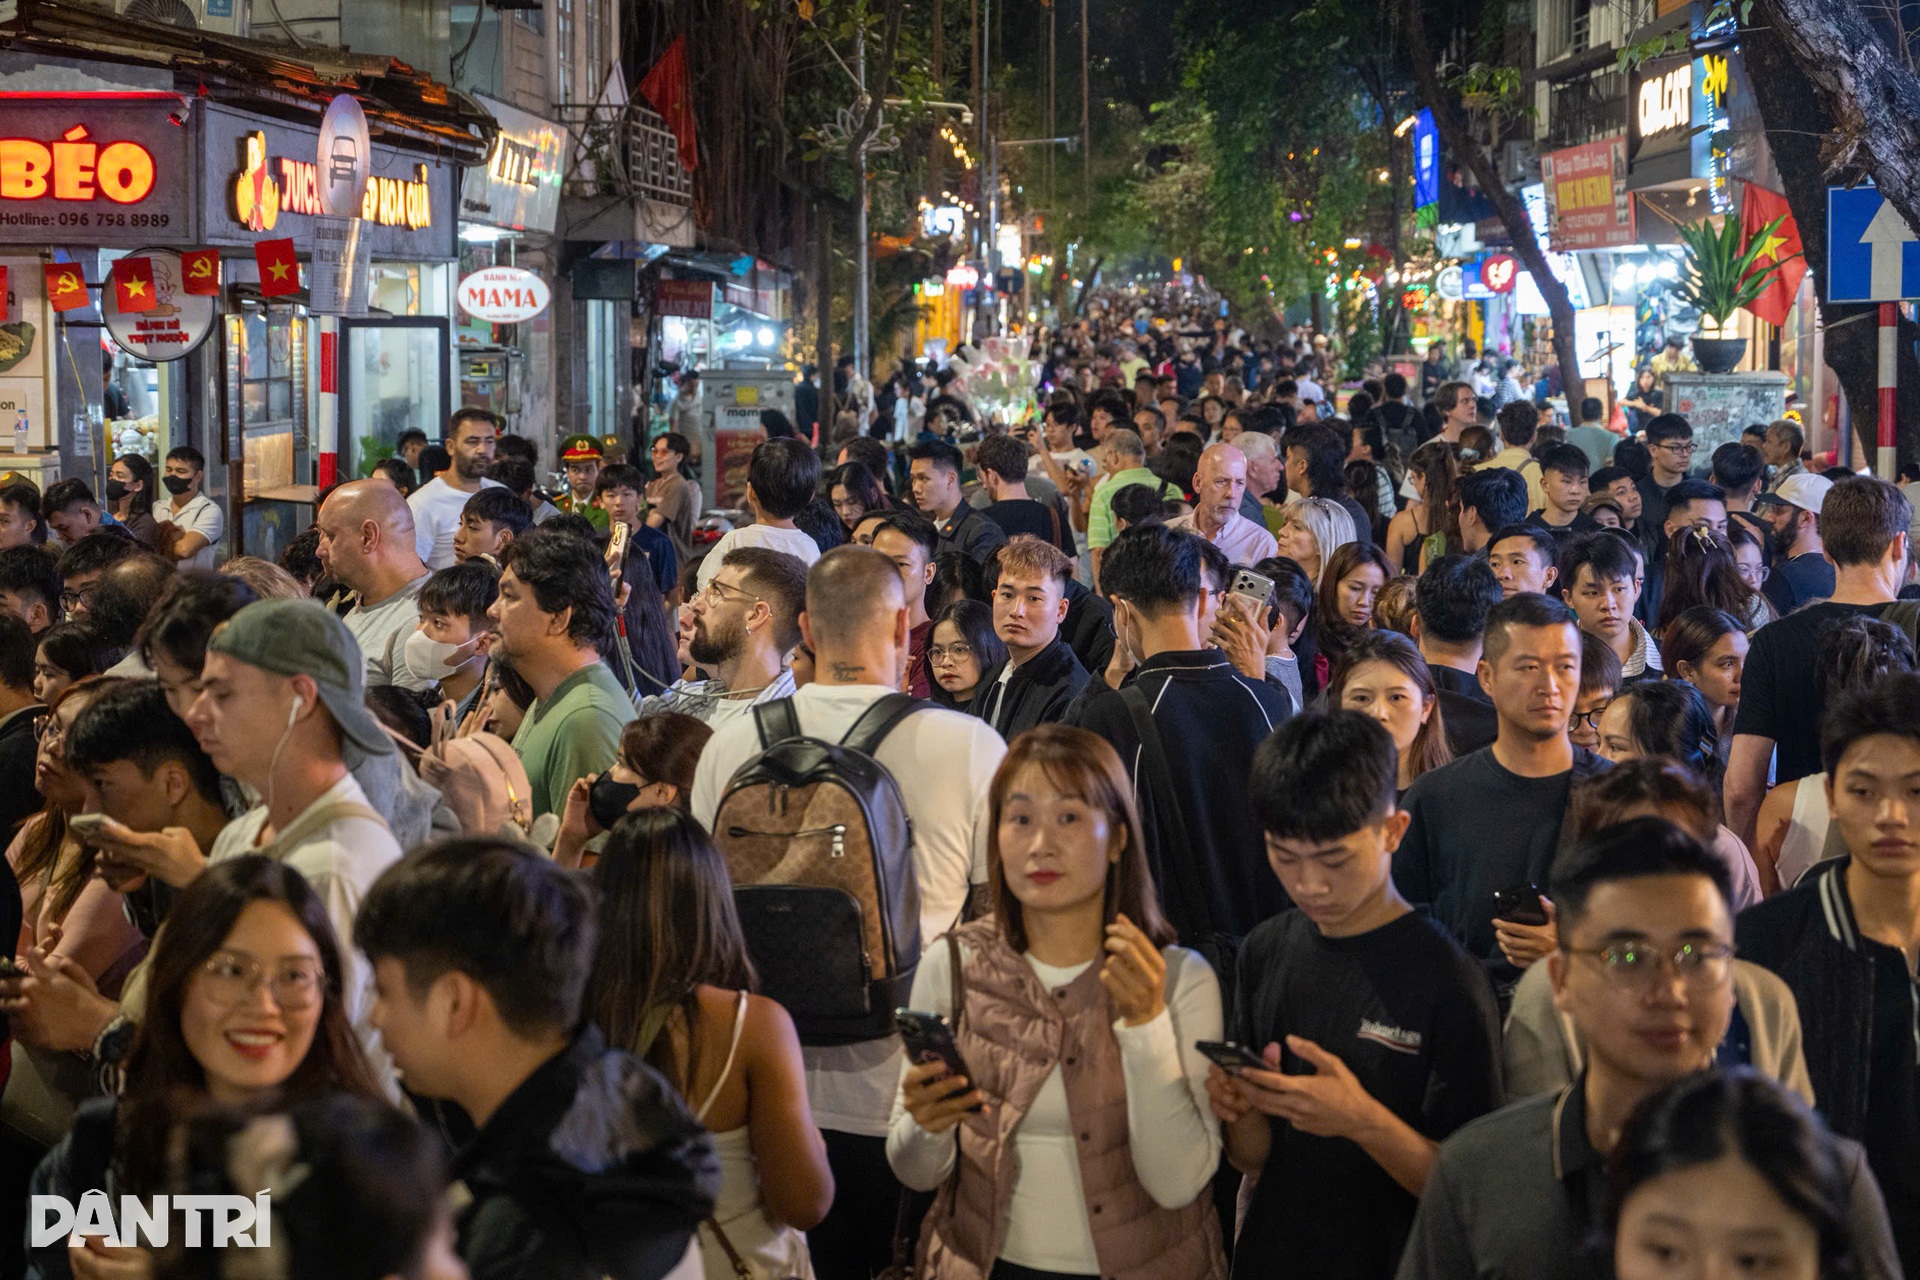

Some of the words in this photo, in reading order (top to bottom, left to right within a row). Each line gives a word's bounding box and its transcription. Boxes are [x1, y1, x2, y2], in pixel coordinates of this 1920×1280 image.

[0, 124, 155, 204] BÉO
[379, 176, 406, 226] HOA
[0, 212, 54, 226] Hotline:
[58, 212, 89, 226] 096
[97, 213, 126, 227] 798
[131, 213, 169, 228] 8989
[468, 288, 537, 308] MAMA
[727, 408, 760, 417] mam
